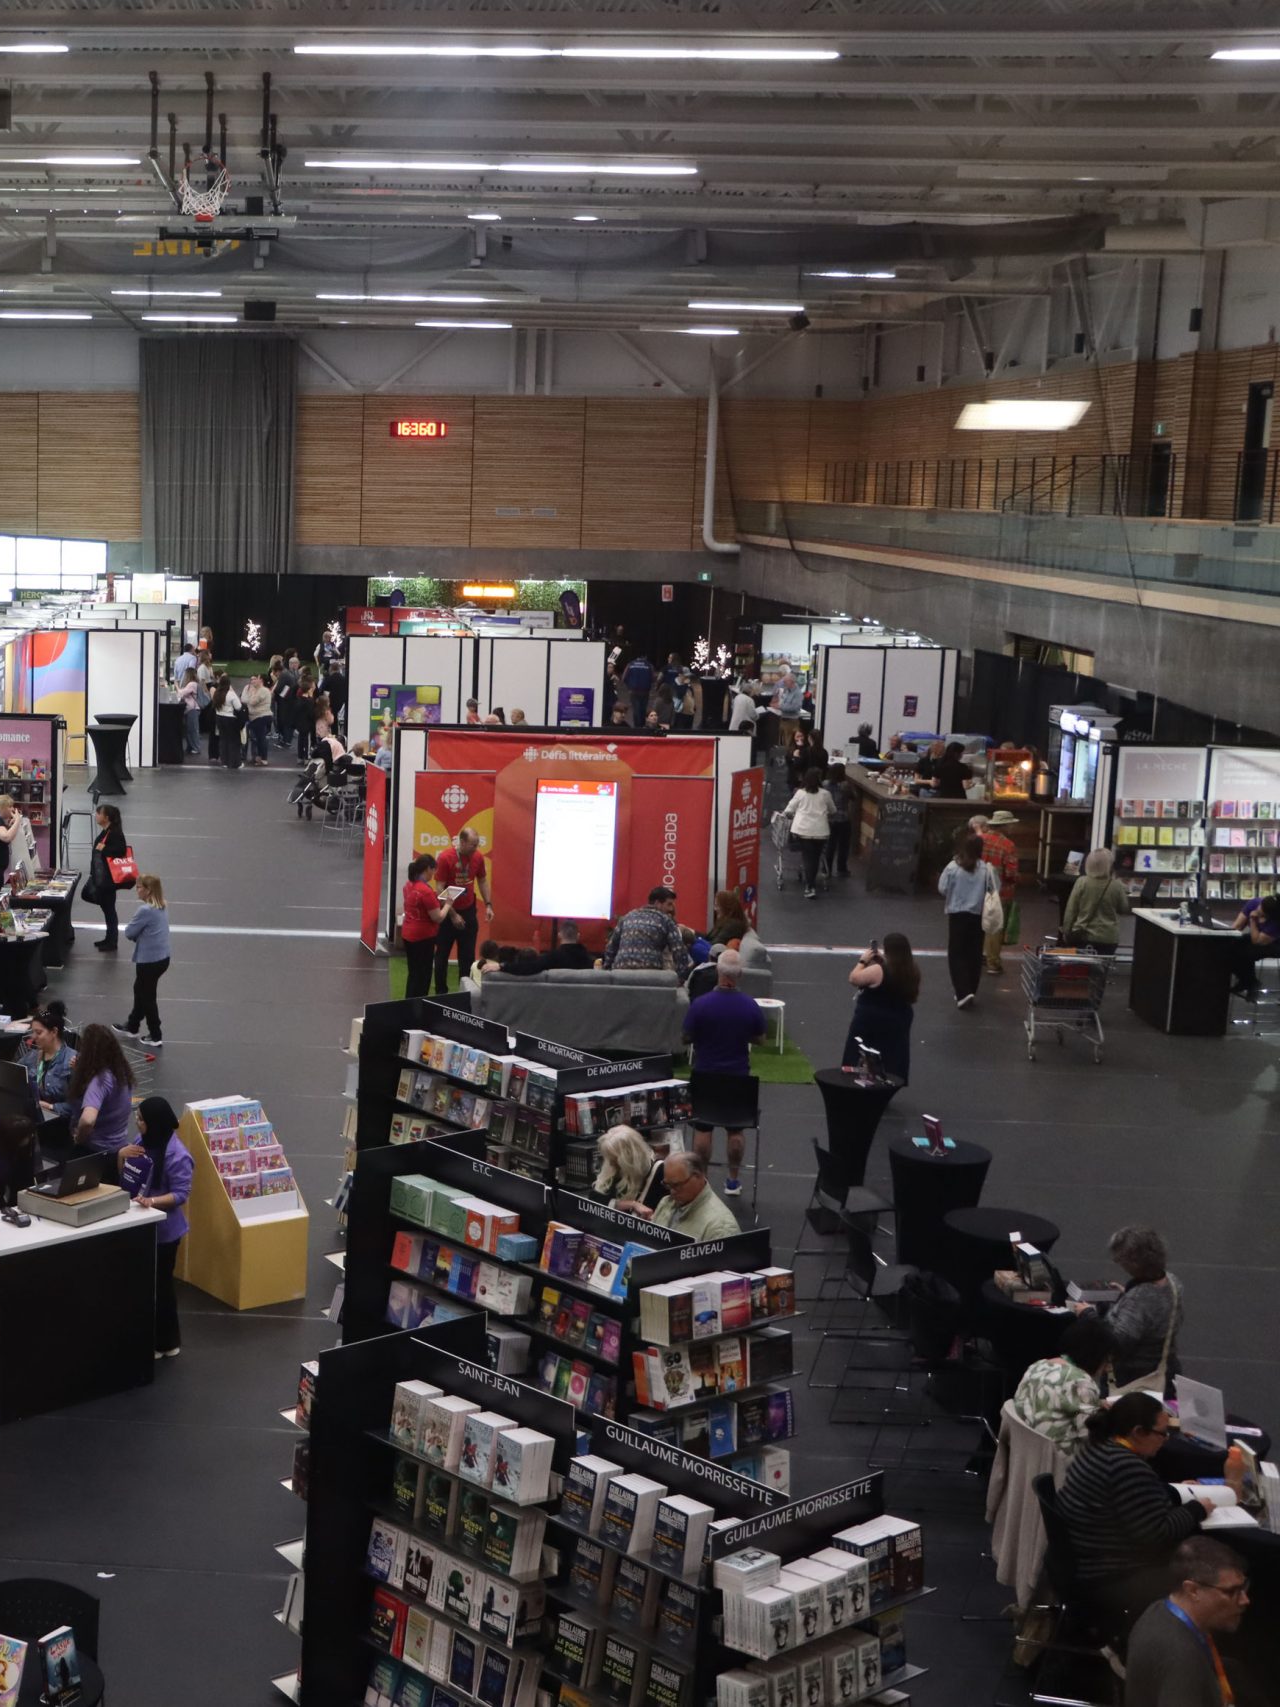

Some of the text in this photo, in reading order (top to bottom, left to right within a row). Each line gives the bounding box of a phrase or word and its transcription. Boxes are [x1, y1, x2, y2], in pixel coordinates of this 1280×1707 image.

[541, 750, 618, 761] Défis littéraires
[733, 803, 758, 828] Défis
[420, 832, 449, 847] Des
[443, 1008, 484, 1029] DE MORTAGNE
[538, 1041, 584, 1063] DE MORTAGNE
[587, 1060, 643, 1077] DE MORTAGNE
[472, 1162, 493, 1178] E.T.C.
[578, 1200, 671, 1242] LUMIÈRE D'EI MORYA
[680, 1242, 724, 1260] BÉLIVEAU
[458, 1362, 520, 1398] SAINT-JEAN
[606, 1425, 773, 1506] GUILLAUME MORRISSETTE
[724, 1480, 872, 1546] GUILLAUME MORRISSETTE
